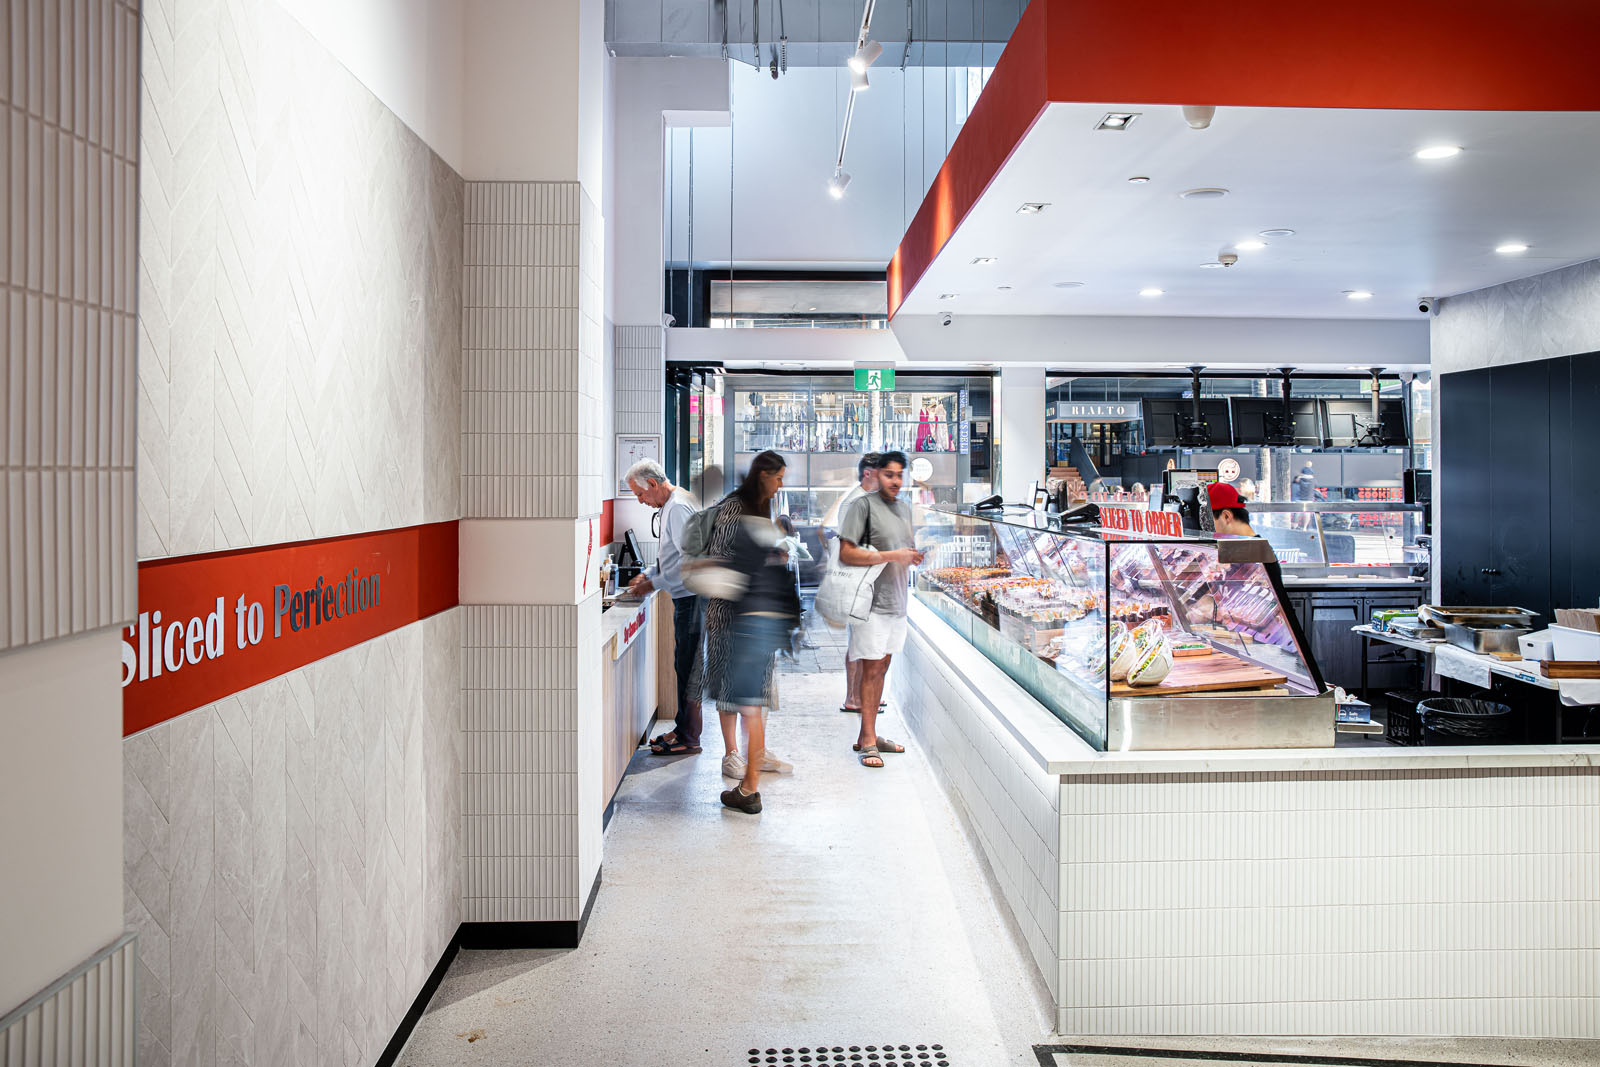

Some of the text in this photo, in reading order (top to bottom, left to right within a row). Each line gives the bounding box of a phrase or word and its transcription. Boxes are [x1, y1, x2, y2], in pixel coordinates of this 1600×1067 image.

[1072, 406, 1125, 415] RIALTO
[1358, 491, 1402, 499] COOKIES
[1100, 506, 1183, 538] SLICED TO ORDER
[235, 593, 264, 650] to
[274, 567, 380, 638] Perfection
